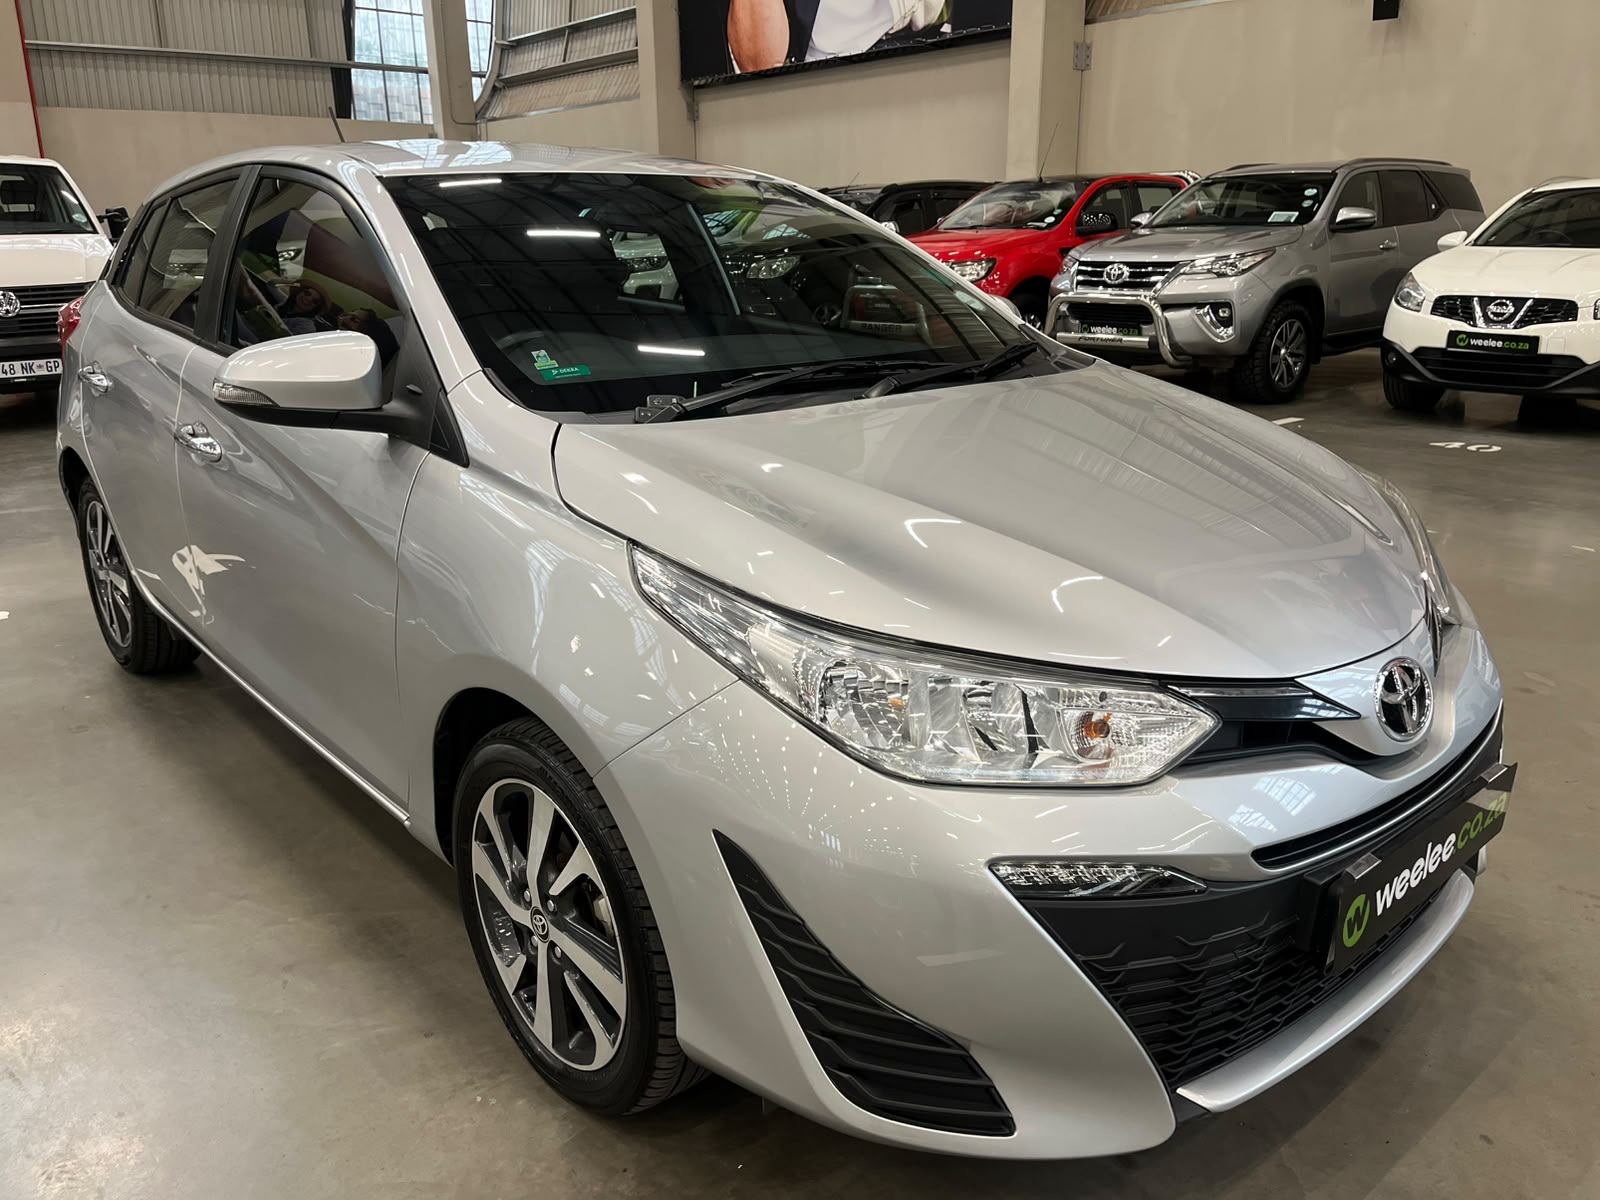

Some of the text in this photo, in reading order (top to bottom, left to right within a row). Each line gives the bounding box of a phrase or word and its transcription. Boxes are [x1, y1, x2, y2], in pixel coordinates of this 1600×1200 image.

[1470, 338, 1529, 350] weelee.co.za
[1, 360, 60, 376] 48 NK GP
[1428, 442, 1502, 452] 40
[1375, 790, 1508, 917] weelee.co.za
